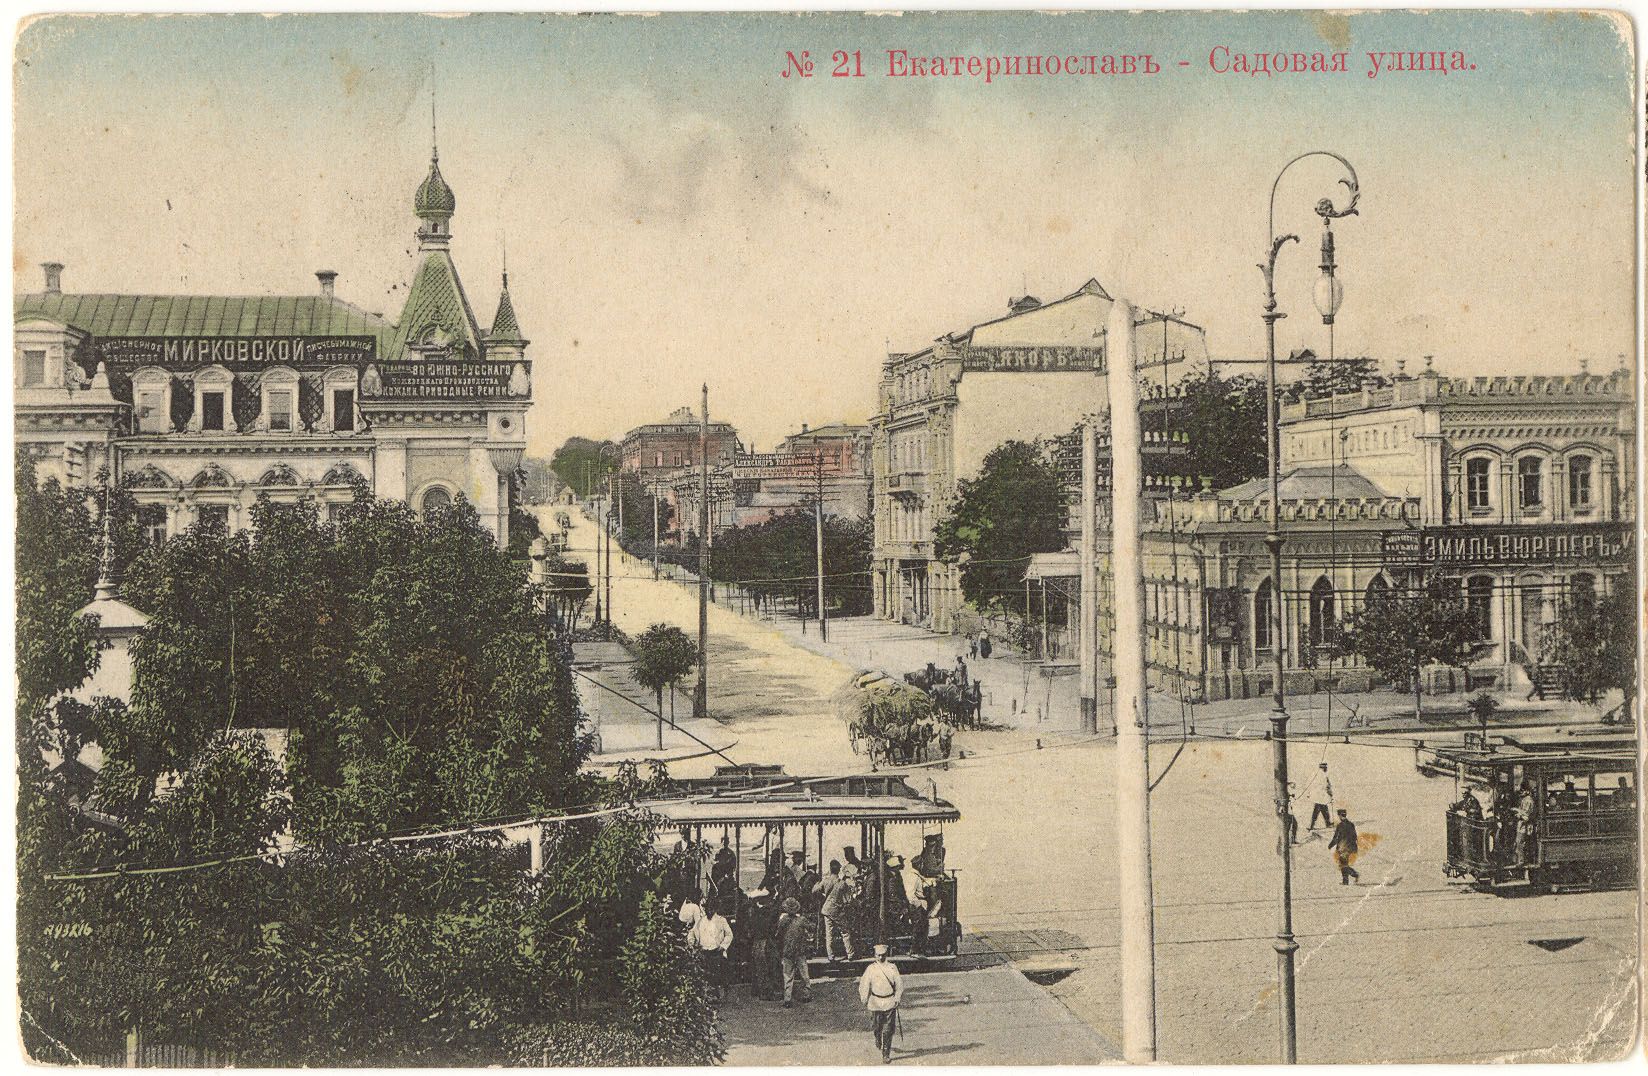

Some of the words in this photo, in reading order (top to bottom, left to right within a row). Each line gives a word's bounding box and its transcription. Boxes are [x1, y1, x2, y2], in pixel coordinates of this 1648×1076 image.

[164, 337, 304, 361] МИРКОВСКОЙ
[427, 363, 511, 376] ЮЖНО-РУССКАГО
[419, 385, 474, 397] ПРИВОДНЫЕ
[477, 385, 508, 397] РЕМНИ
[1425, 536, 1494, 560] ЭМИЛЬ
